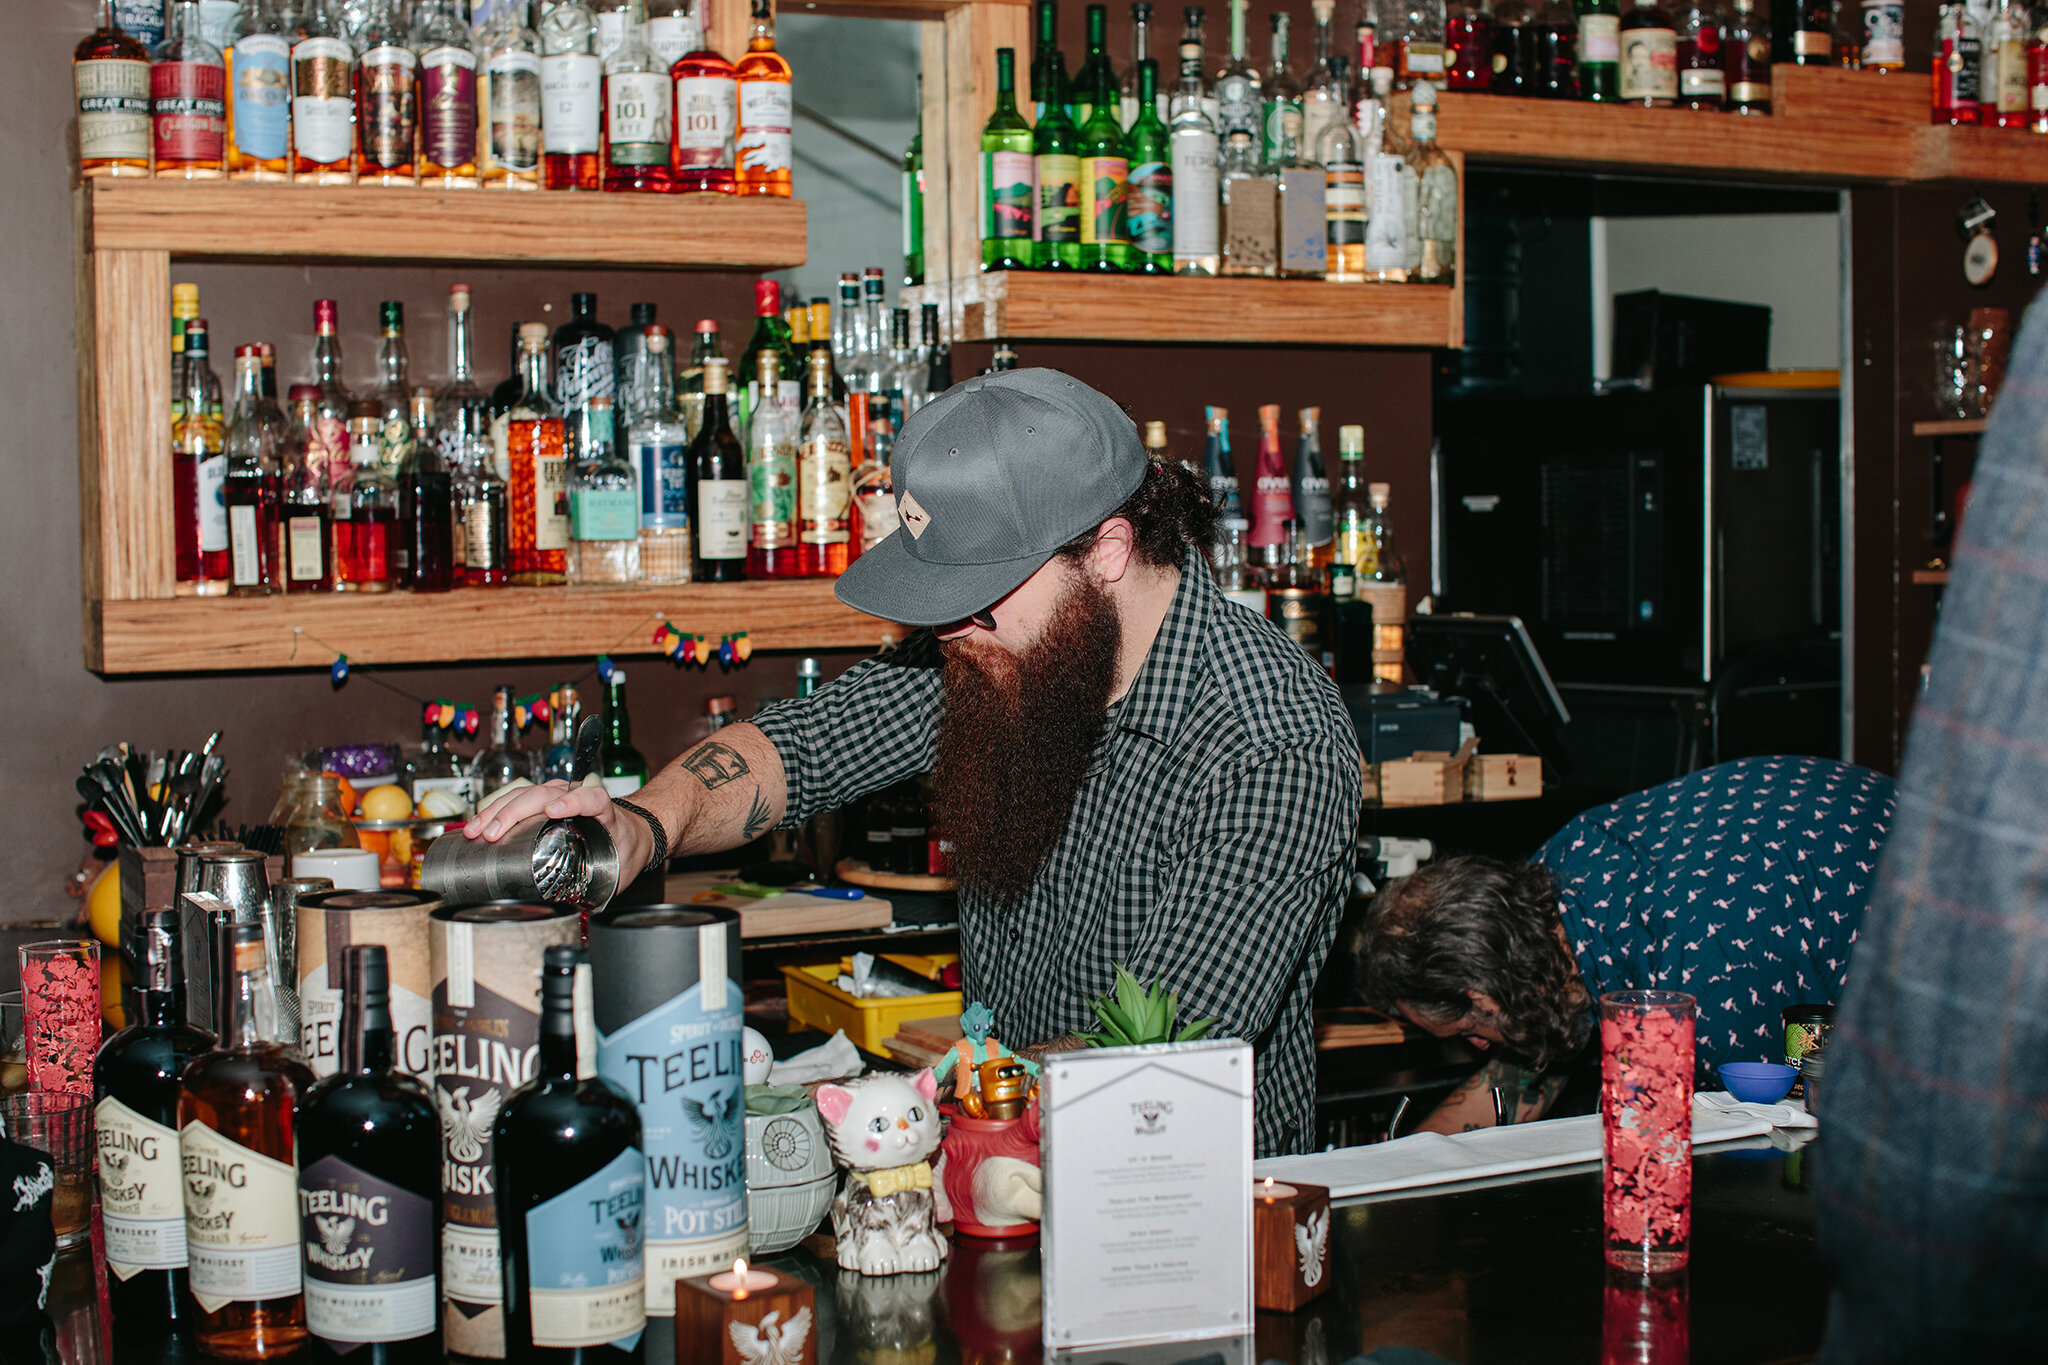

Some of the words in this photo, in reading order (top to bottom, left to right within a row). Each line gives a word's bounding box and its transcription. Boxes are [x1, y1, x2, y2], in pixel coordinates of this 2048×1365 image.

[82, 98, 120, 110] GREAT
[156, 99, 193, 111] GREAT
[195, 100, 223, 112] KING
[615, 103, 647, 119] 101
[687, 115, 718, 131] 101
[434, 1033, 541, 1089] ELIN
[626, 1040, 744, 1105] TEELI
[97, 1128, 158, 1161] EELING
[182, 1154, 246, 1189] EELING
[441, 1157, 497, 1197] HISK
[648, 1149, 745, 1191] WHISKE
[299, 1186, 389, 1227] TEELING
[588, 1185, 644, 1225] TEELI
[664, 1204, 710, 1237] POT
[115, 1226, 158, 1238] WHISKEY
[306, 1241, 375, 1272] WHISKEY
[459, 1245, 501, 1258] WHIS
[661, 1255, 706, 1269] IRISH
